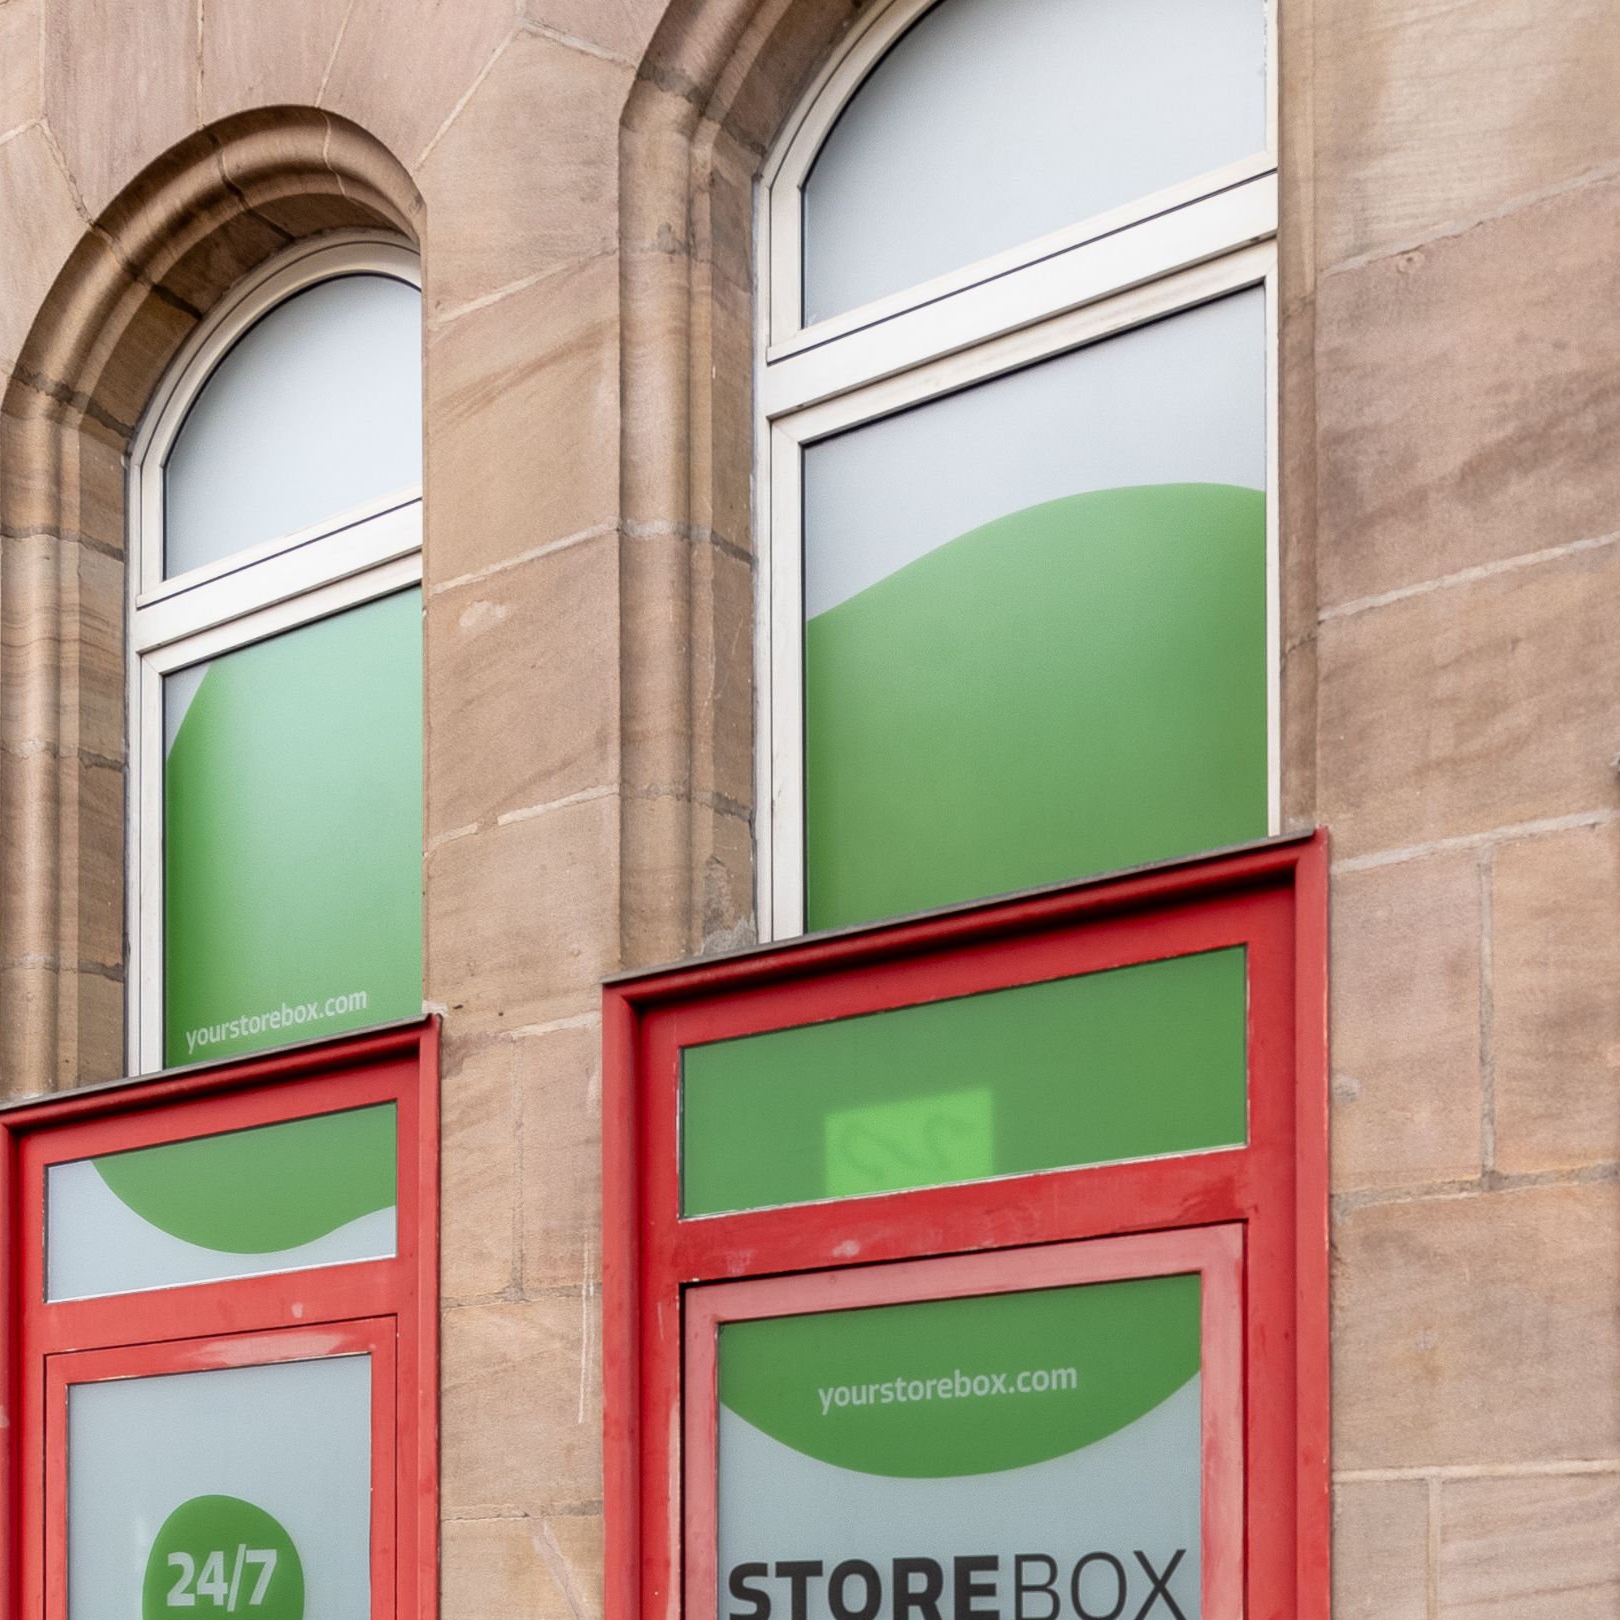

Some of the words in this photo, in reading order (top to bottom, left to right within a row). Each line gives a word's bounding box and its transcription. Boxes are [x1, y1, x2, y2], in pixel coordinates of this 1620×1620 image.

[185, 989, 368, 1057] yourstorebox.com
[817, 1363, 1078, 1415] yourstorebox.com
[166, 1544, 277, 1612] 24/7
